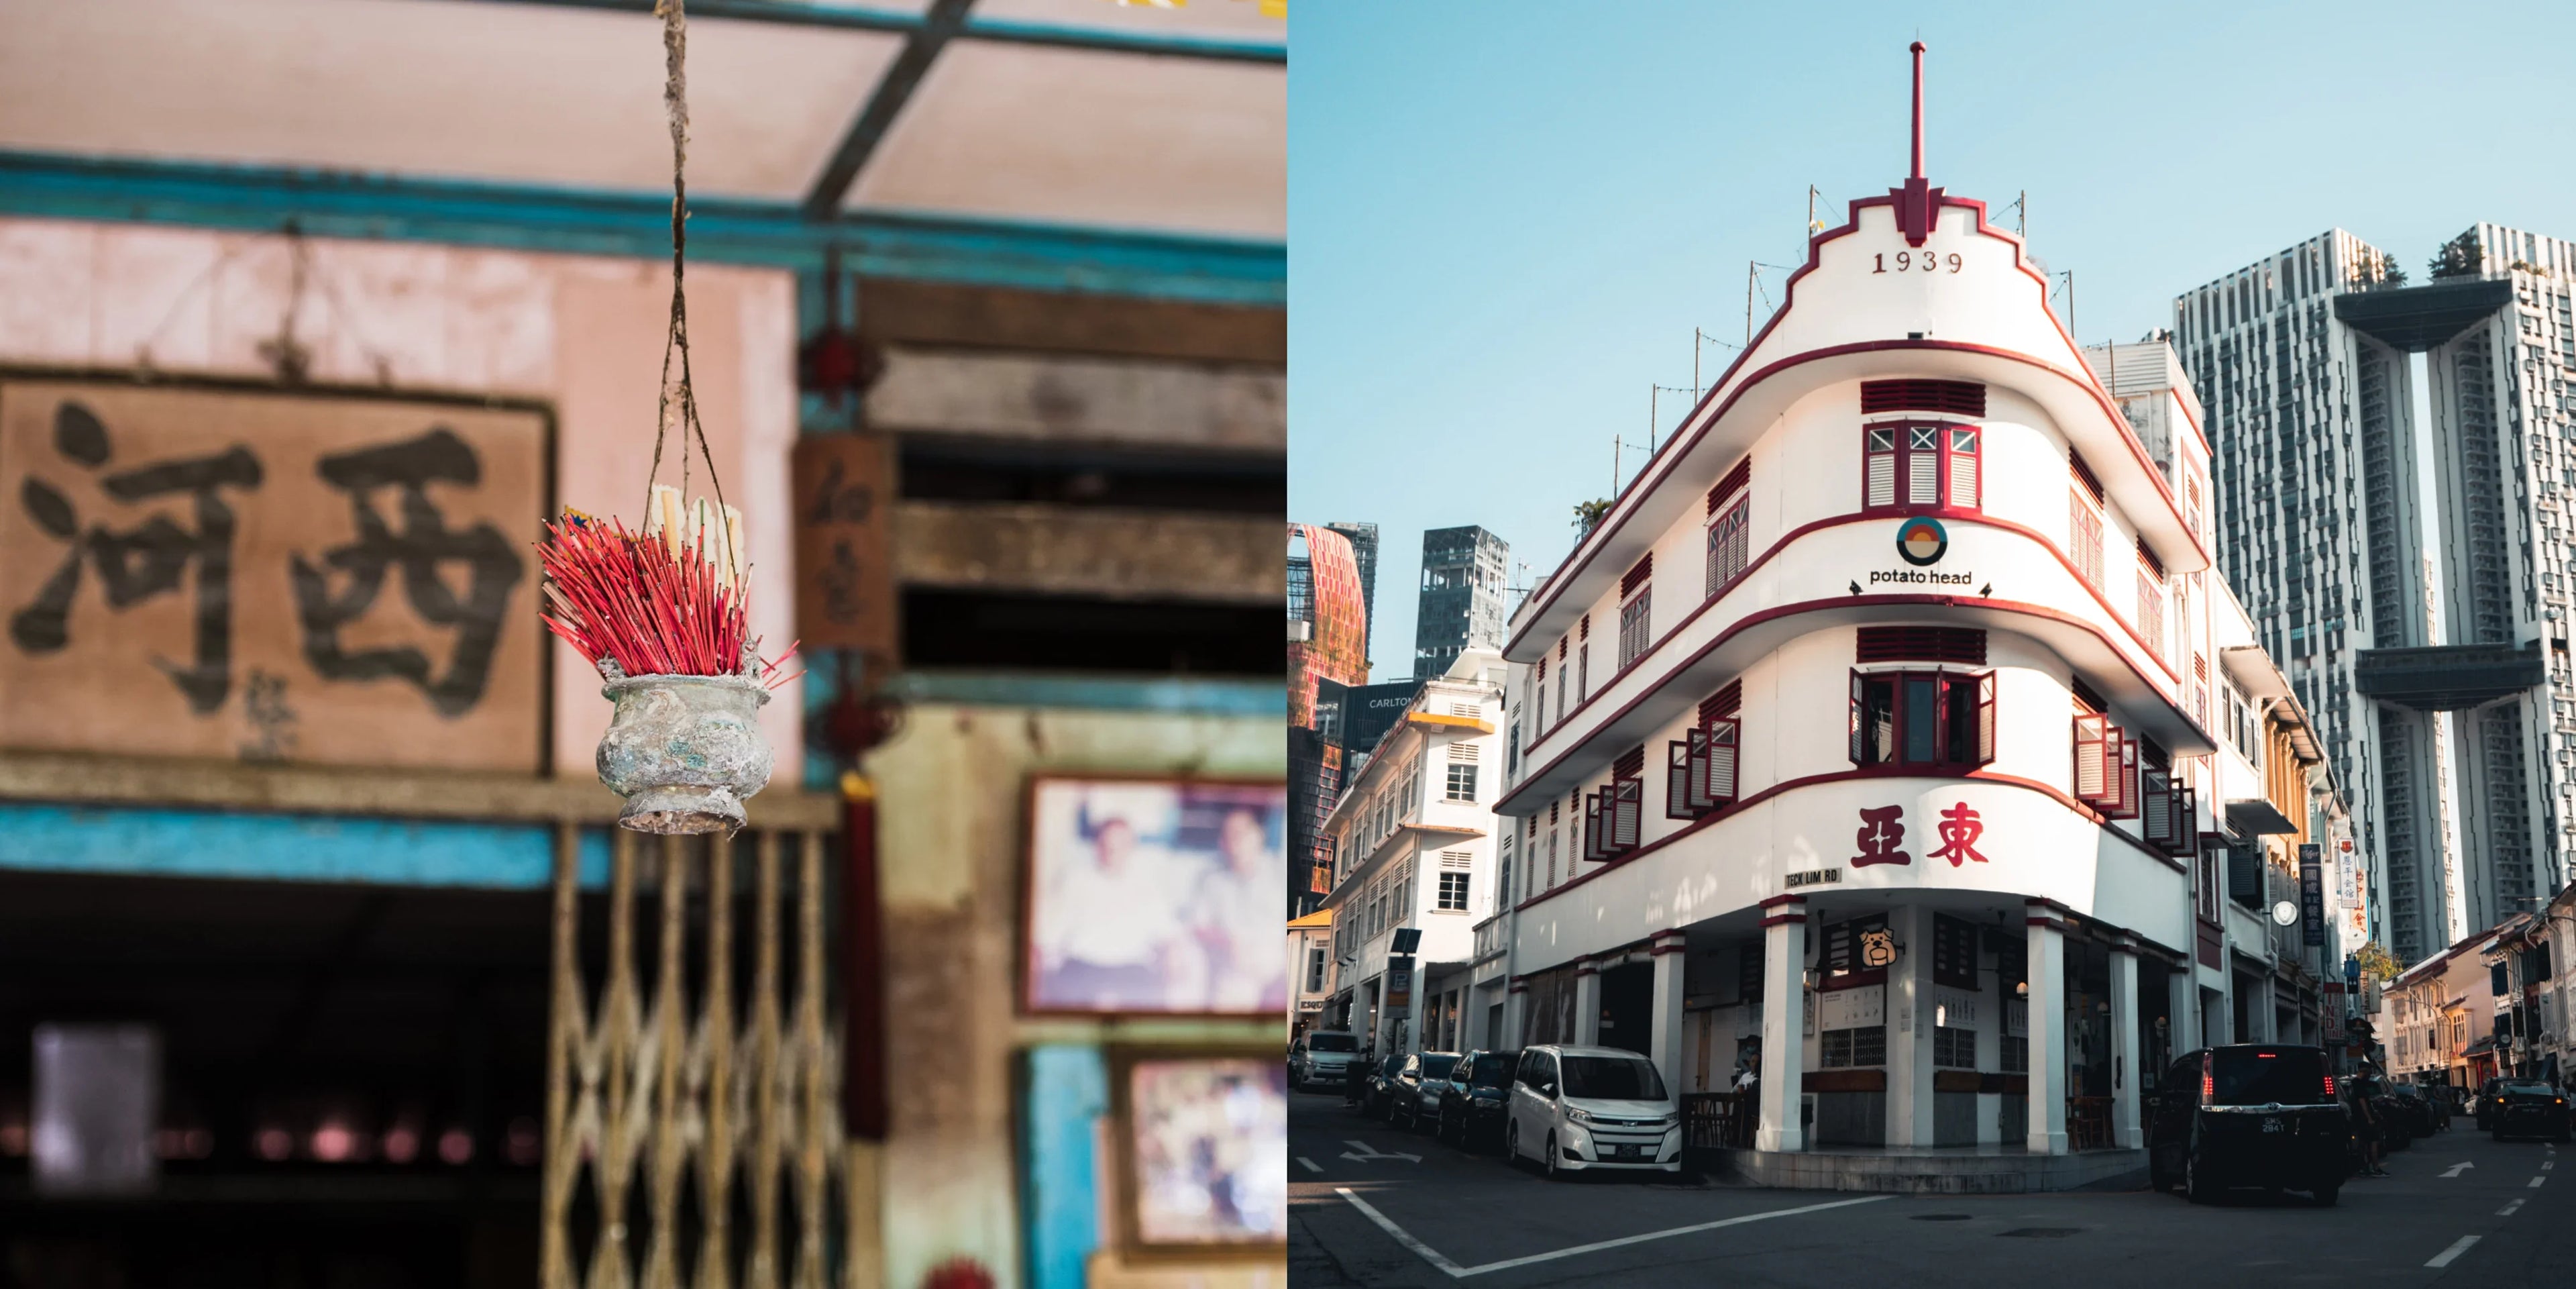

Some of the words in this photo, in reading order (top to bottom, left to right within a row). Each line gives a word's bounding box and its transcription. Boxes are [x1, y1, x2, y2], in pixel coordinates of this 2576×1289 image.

[1871, 250, 1963, 274] 1939
[1870, 568, 1926, 585] potato
[1929, 570, 1972, 585] head
[2300, 849, 2320, 859] Tiger
[1786, 873, 1803, 887] TECK
[1806, 870, 1821, 884] LIM
[1825, 869, 1837, 882] RD
